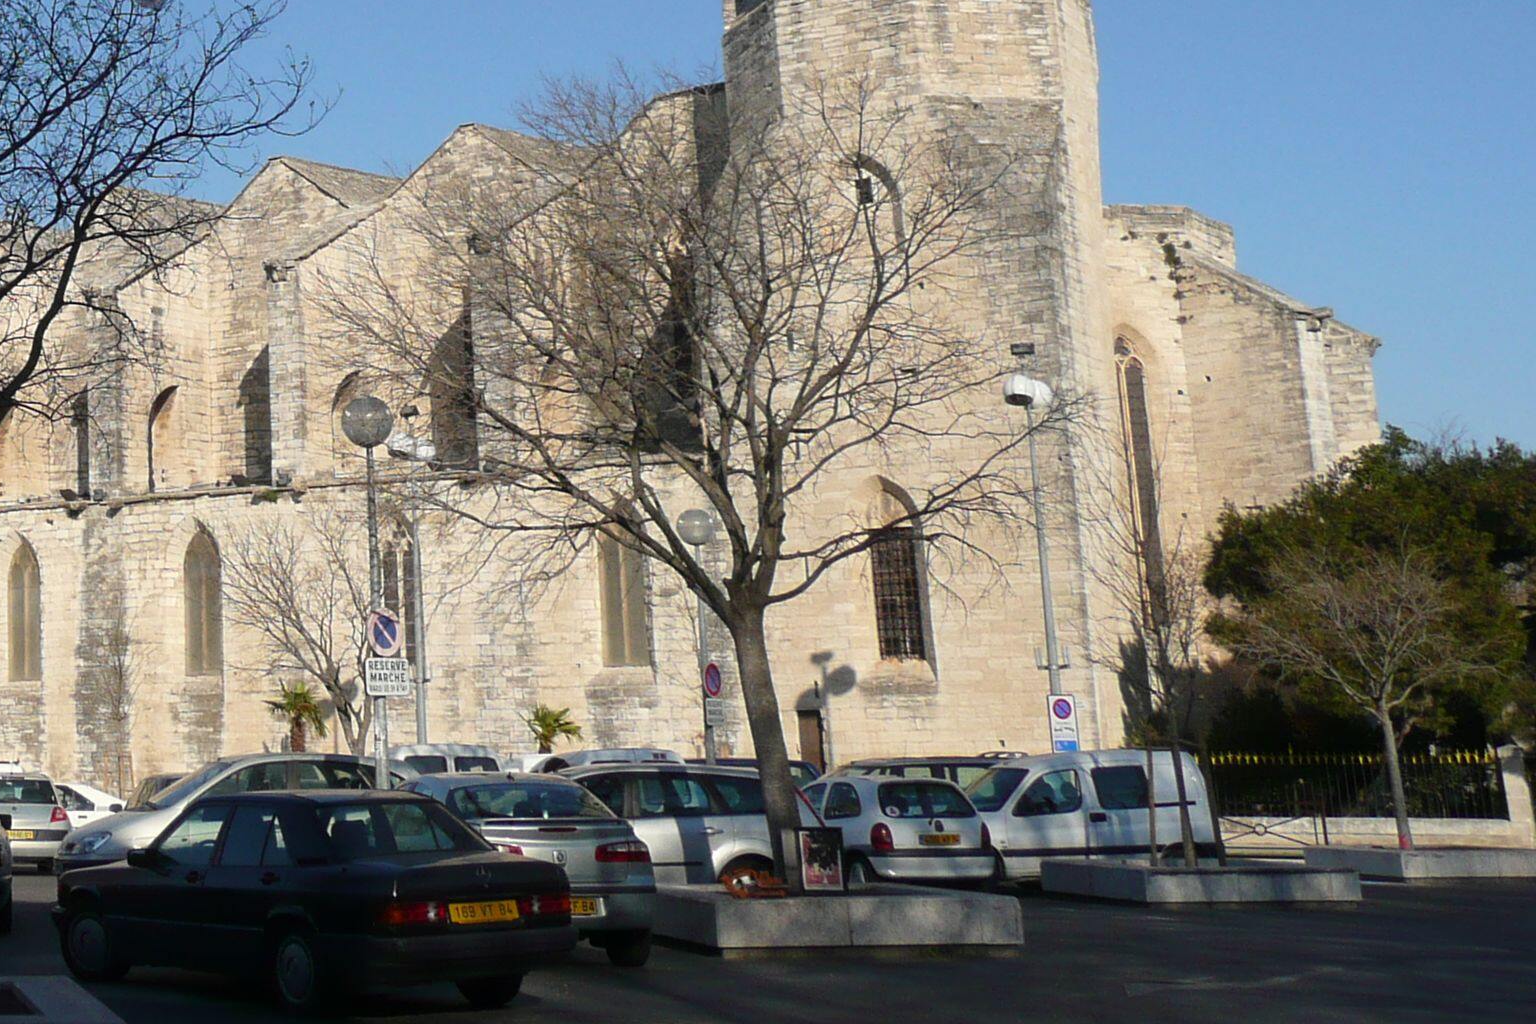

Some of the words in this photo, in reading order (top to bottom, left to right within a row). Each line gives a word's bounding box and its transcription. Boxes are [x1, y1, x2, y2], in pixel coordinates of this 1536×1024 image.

[368, 660, 406, 671] RESERVE
[370, 672, 406, 683] MARCHE
[480, 903, 494, 916] VT
[499, 902, 513, 915] 84
[582, 900, 595, 913] 84
